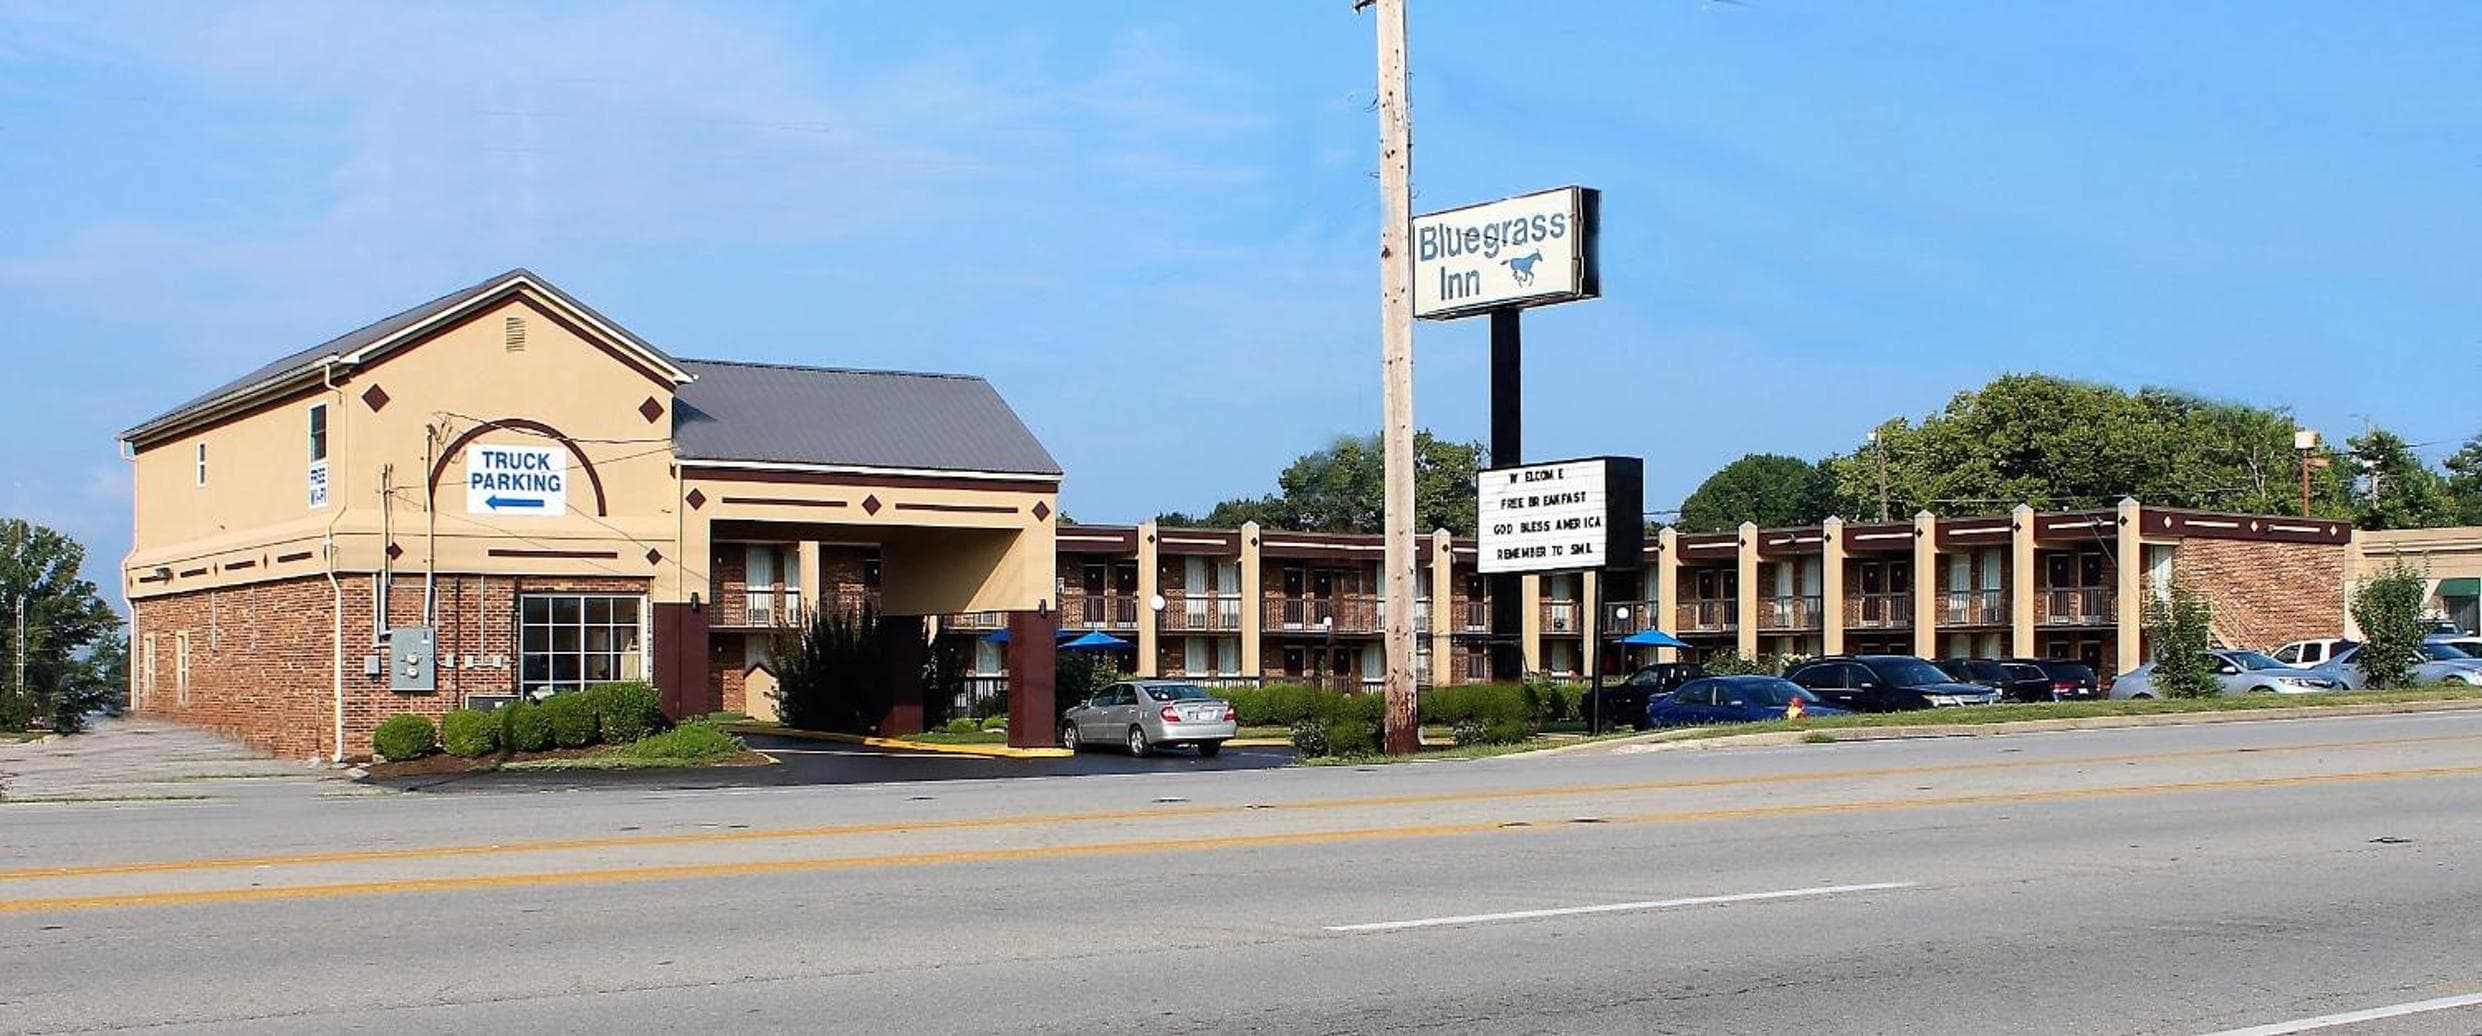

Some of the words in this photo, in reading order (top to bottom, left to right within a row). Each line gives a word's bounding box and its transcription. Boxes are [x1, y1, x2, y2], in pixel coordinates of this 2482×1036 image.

[1419, 212, 1566, 262] Bluegrass
[1440, 266, 1480, 301] Inn
[481, 450, 551, 471] TRUCK
[471, 472, 562, 492] PARKING
[1500, 497, 1524, 510] FREE
[1528, 491, 1587, 508] BREAKFAST
[1493, 524, 1513, 536] GOD
[1520, 520, 1551, 534] BLESS
[1555, 516, 1601, 531] AMERICA
[1497, 546, 1547, 560] REMEMBER
[1551, 545, 1563, 556] TO
